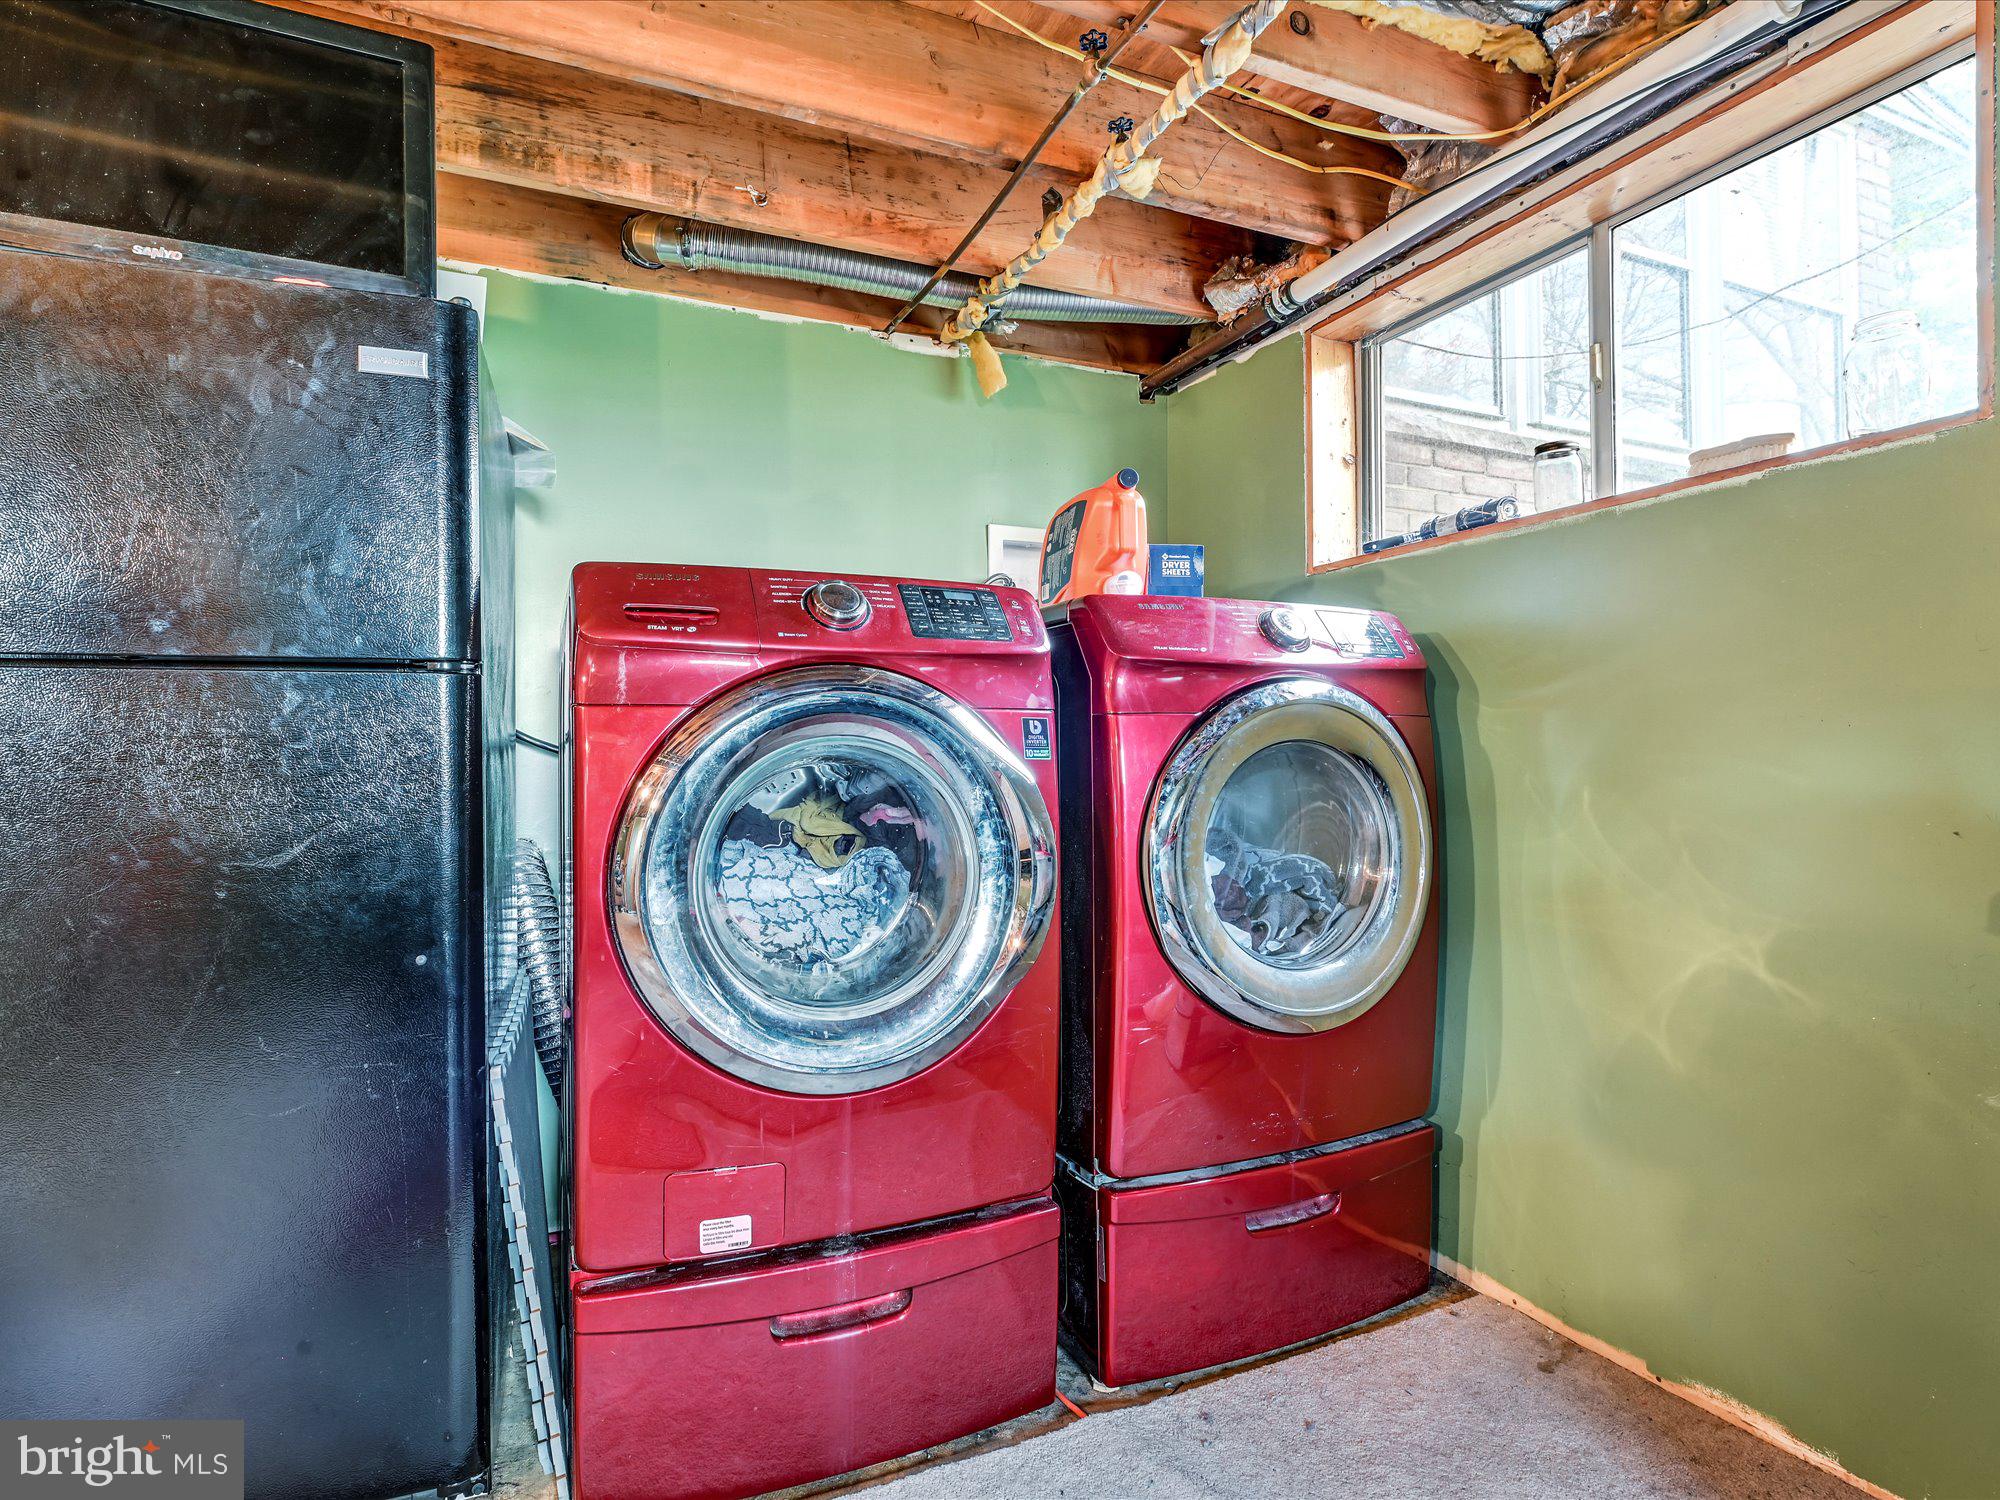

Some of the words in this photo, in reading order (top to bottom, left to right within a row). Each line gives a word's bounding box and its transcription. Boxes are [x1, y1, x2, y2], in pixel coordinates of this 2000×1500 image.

[132, 245, 183, 260] SANYO
[1161, 561, 1191, 569] DRYER
[1161, 568, 1191, 576] SHEETS
[635, 573, 700, 582] SAMSUNG
[1025, 749, 1034, 758] 10
